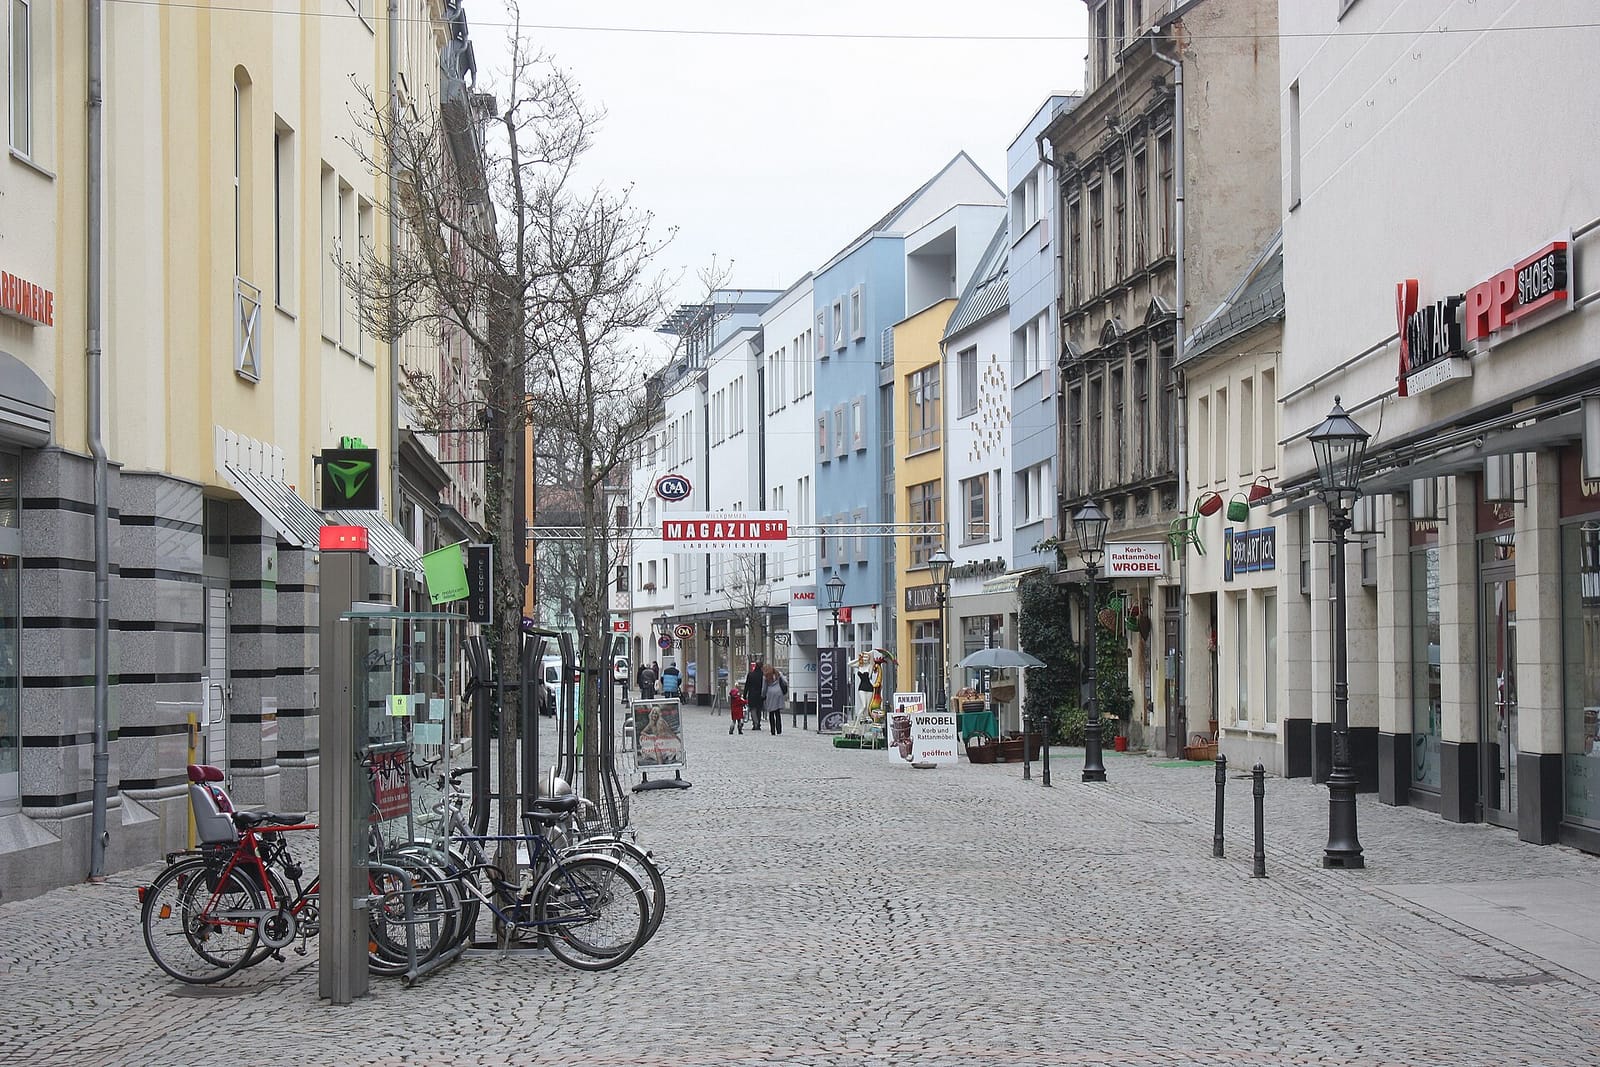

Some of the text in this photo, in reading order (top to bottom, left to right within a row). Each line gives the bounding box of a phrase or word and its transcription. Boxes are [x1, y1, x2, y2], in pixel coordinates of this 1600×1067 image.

[0, 270, 53, 327] RFUMERIE
[1466, 254, 1555, 341] PP SHOES
[662, 481, 685, 494] C&A
[667, 523, 784, 538] MAGAZIN STR
[1247, 537, 1259, 562] ART
[1113, 563, 1161, 571] WROBEL
[793, 592, 815, 600] KANZ
[804, 664, 816, 672] 18
[820, 651, 834, 709] LUXOR
[915, 717, 955, 725] WROBEL
[922, 749, 952, 758] geöffnet
